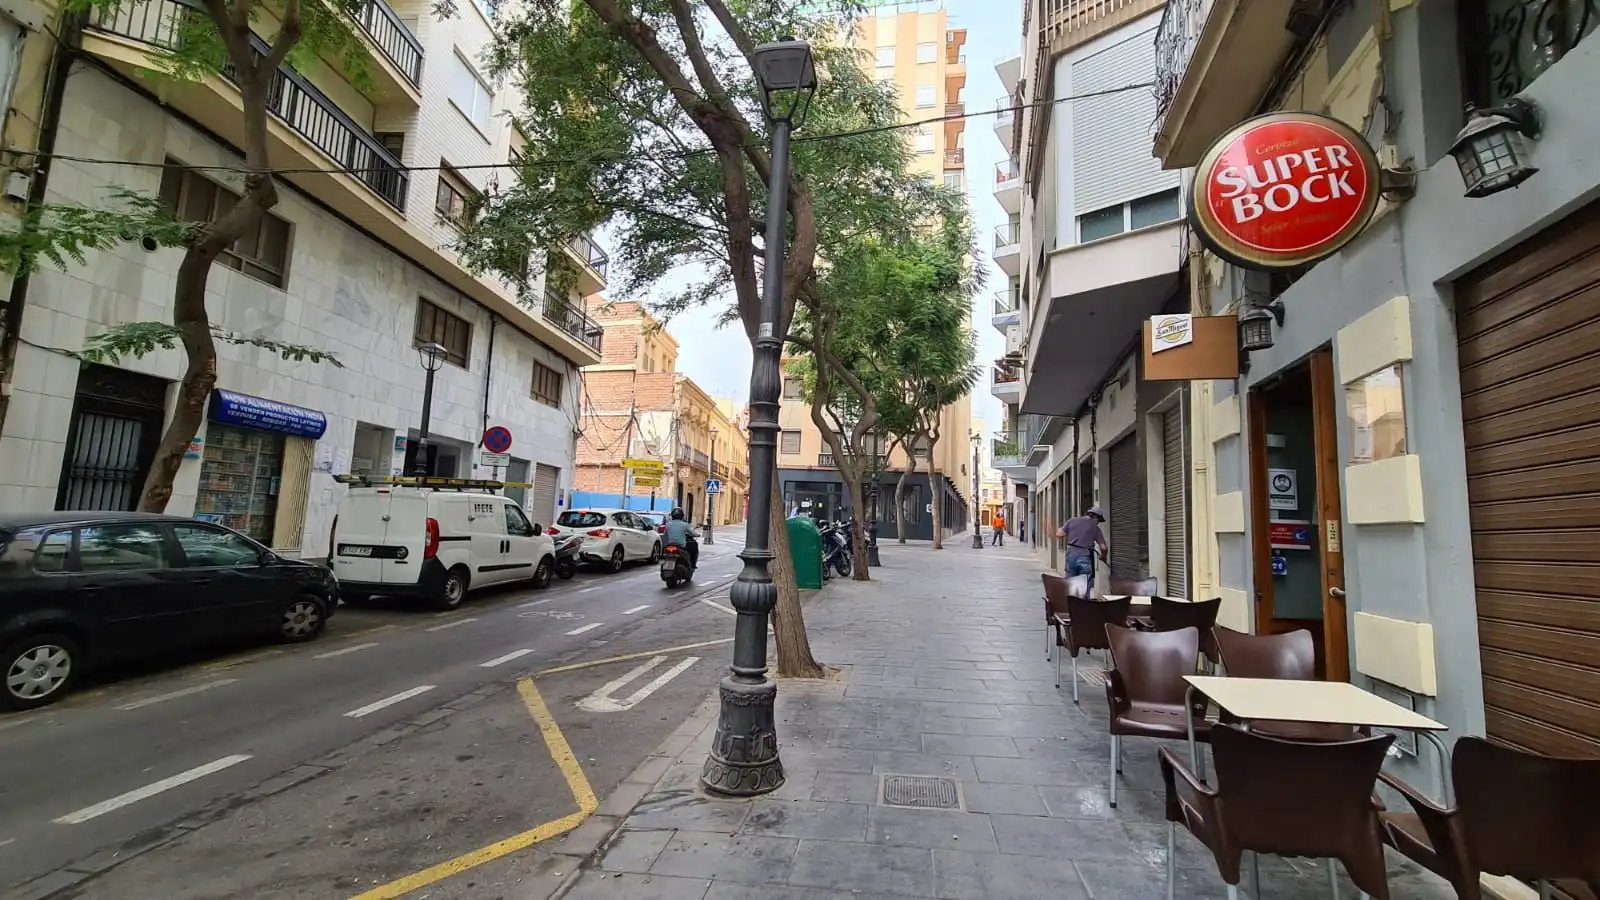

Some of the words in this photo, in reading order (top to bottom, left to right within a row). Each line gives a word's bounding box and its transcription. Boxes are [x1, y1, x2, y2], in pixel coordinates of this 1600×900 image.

[1216, 144, 1353, 198] SUPER
[1232, 170, 1356, 224] BOCK
[265, 410, 299, 422] PRODUCTOS
